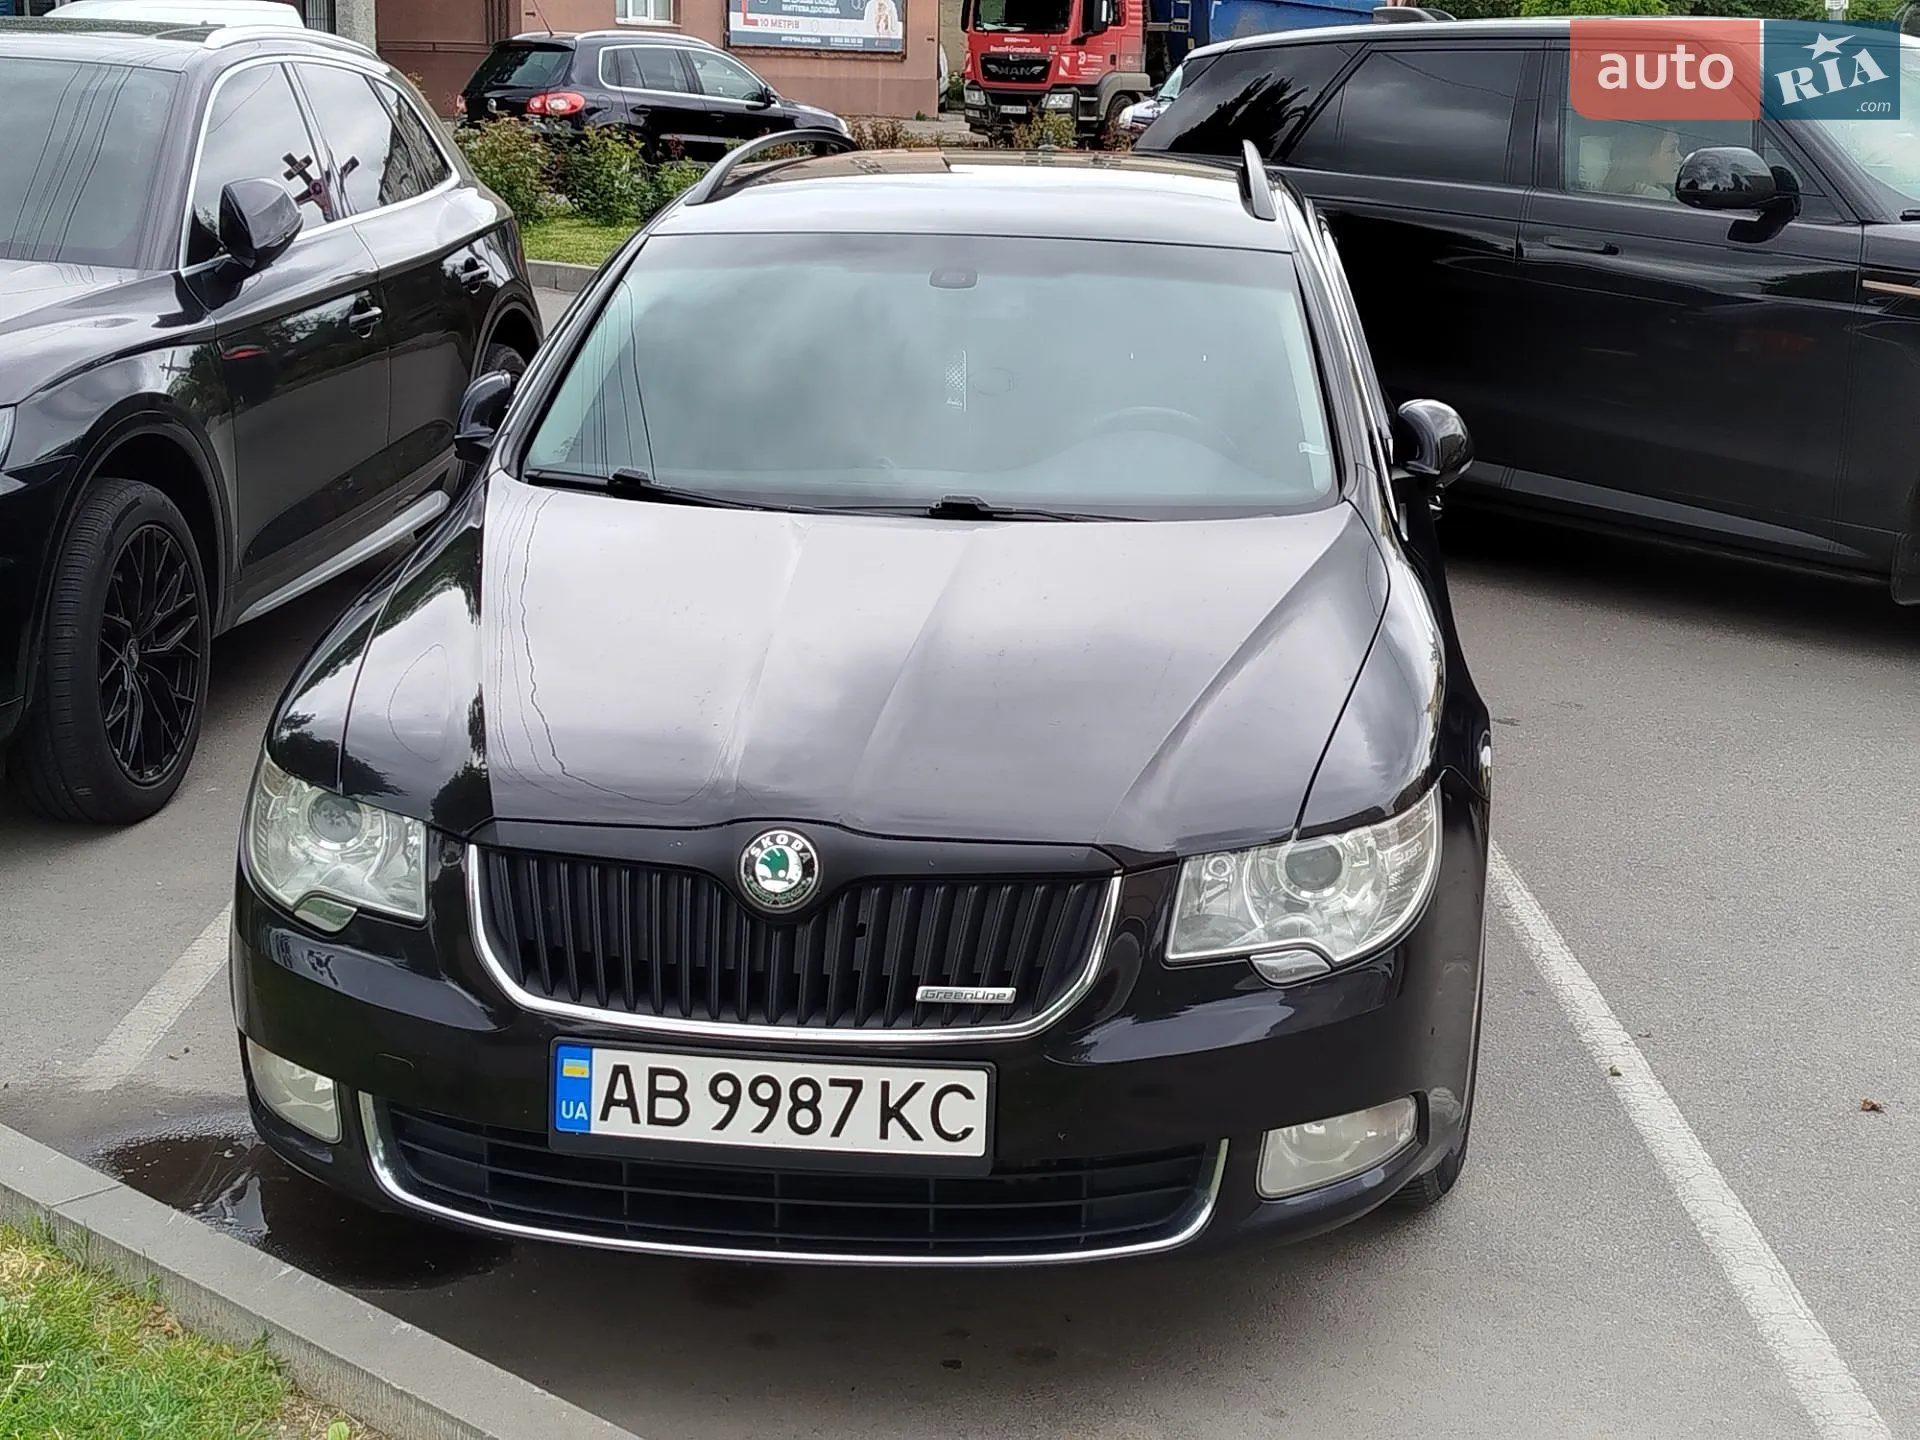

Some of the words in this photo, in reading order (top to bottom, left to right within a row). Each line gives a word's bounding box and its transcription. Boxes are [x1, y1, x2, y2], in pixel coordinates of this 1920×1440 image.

[759, 18, 769, 27] 10
[770, 19, 800, 29] МЕТРІВ
[561, 1101, 588, 1120] UA
[599, 1064, 691, 1128] AB
[708, 1072, 864, 1138] 9987
[879, 1080, 976, 1143] KC
